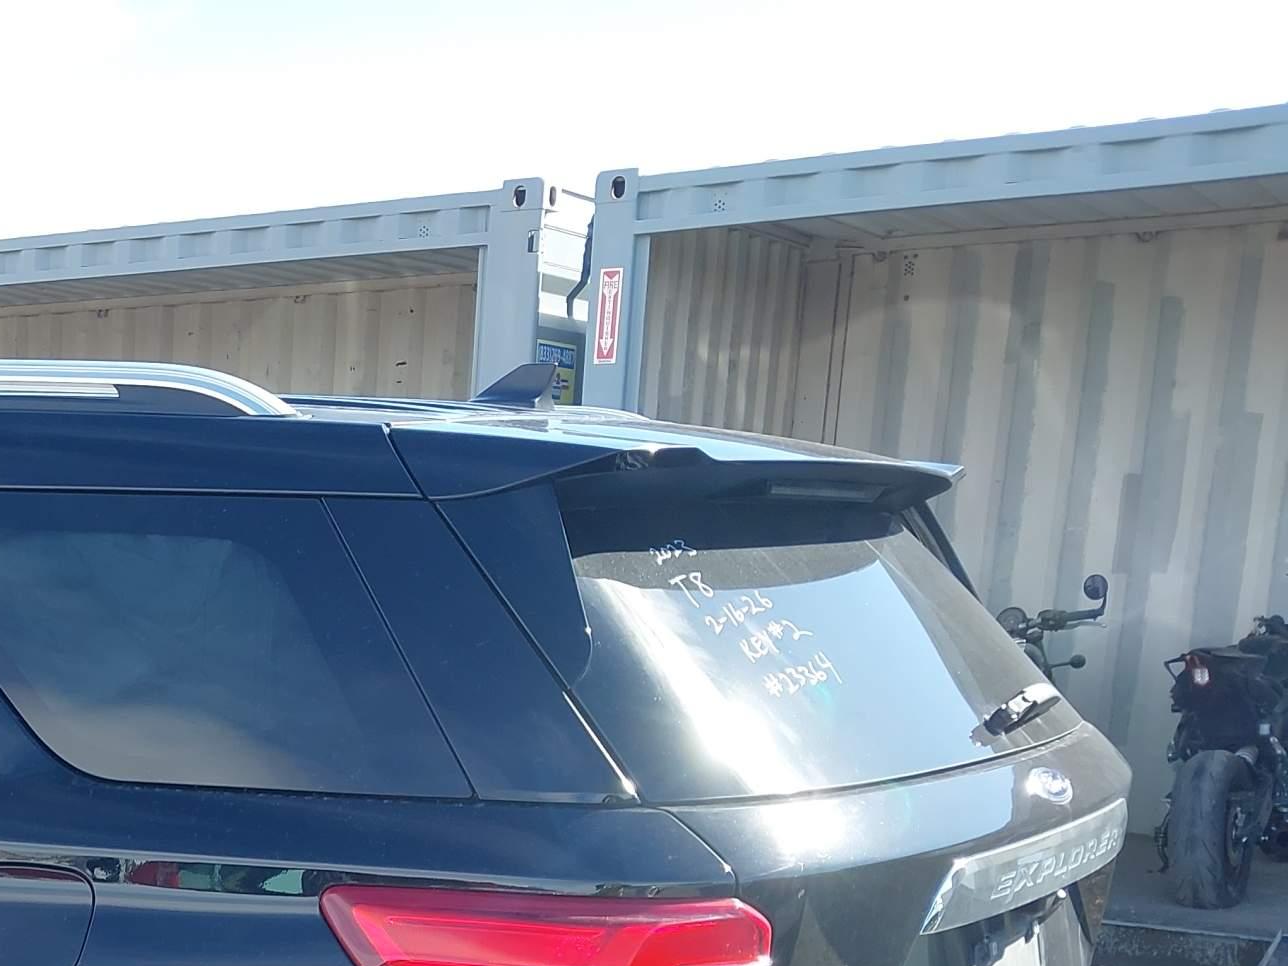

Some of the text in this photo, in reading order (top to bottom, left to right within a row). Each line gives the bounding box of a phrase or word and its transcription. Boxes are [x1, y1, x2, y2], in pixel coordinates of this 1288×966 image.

[603, 280, 618, 289] FIRE
[704, 589, 773, 635] 2-16-26
[990, 829, 1120, 901] EXPLORER
